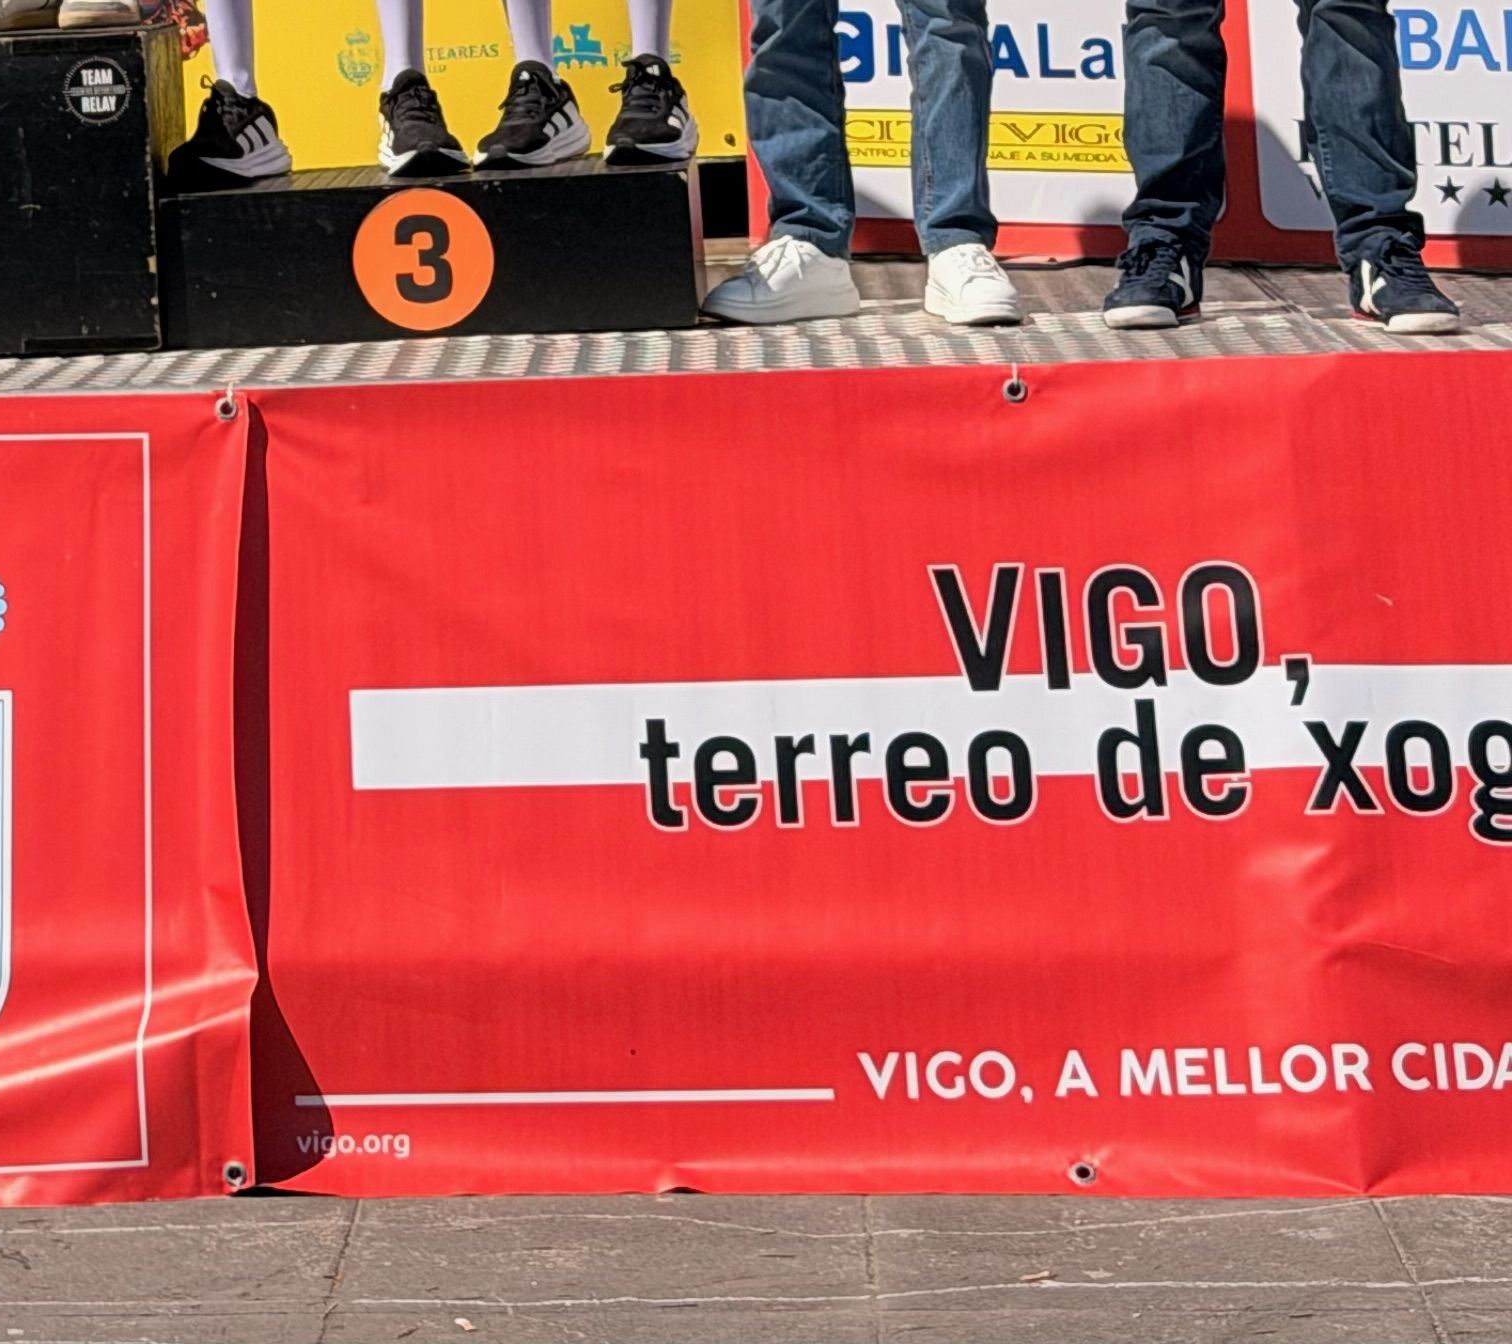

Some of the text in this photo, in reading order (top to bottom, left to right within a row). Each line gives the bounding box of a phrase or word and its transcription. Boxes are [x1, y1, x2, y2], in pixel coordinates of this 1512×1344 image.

[80, 68, 113, 86] TEAM
[81, 96, 116, 112] RELAY
[849, 147, 897, 158] ENTRO
[391, 211, 454, 305] 3
[927, 561, 1314, 709] VIGO,
[638, 717, 1036, 833] terreo
[1095, 698, 1251, 823] de
[856, 1049, 1035, 1105] VIGO,
[1055, 1048, 1100, 1099] A
[1118, 1042, 1373, 1099] MELLOR
[296, 1130, 410, 1158] vigo.org
